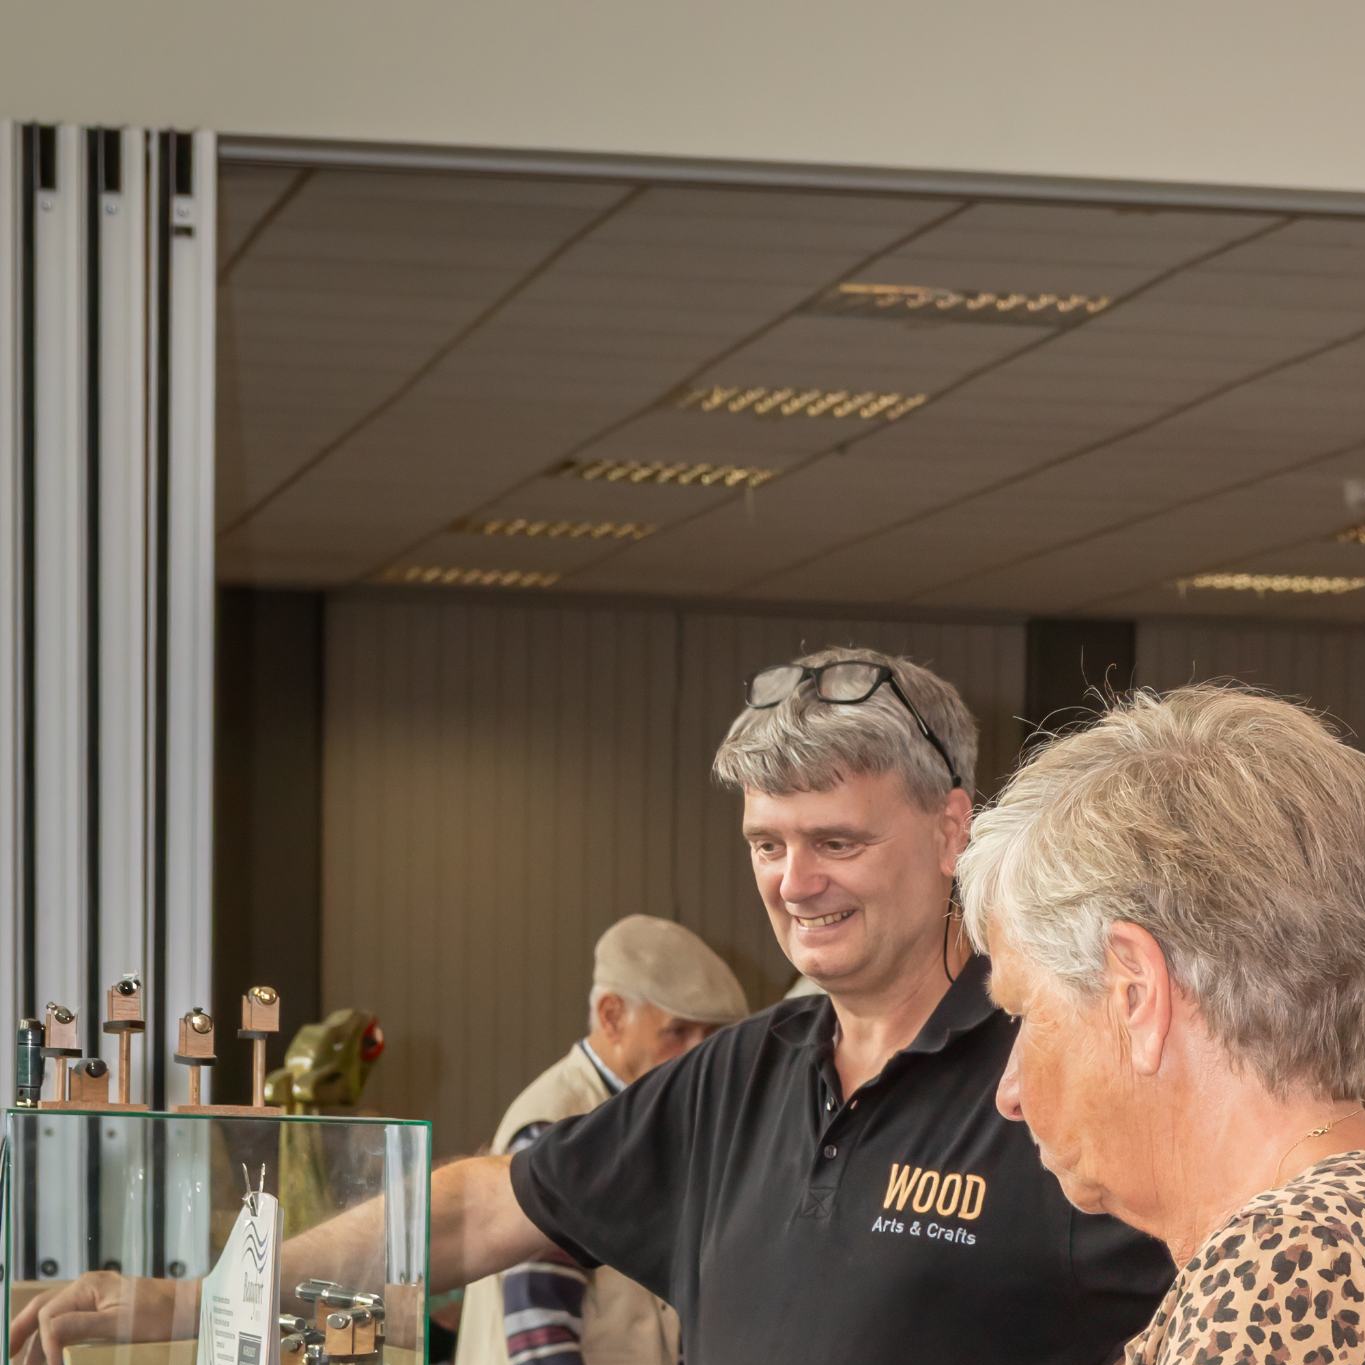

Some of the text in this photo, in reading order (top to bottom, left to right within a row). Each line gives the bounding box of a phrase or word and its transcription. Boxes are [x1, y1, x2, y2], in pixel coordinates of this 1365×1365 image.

[883, 1163, 987, 1220] WOOD
[871, 1216, 976, 1246] Arts & Crafts
